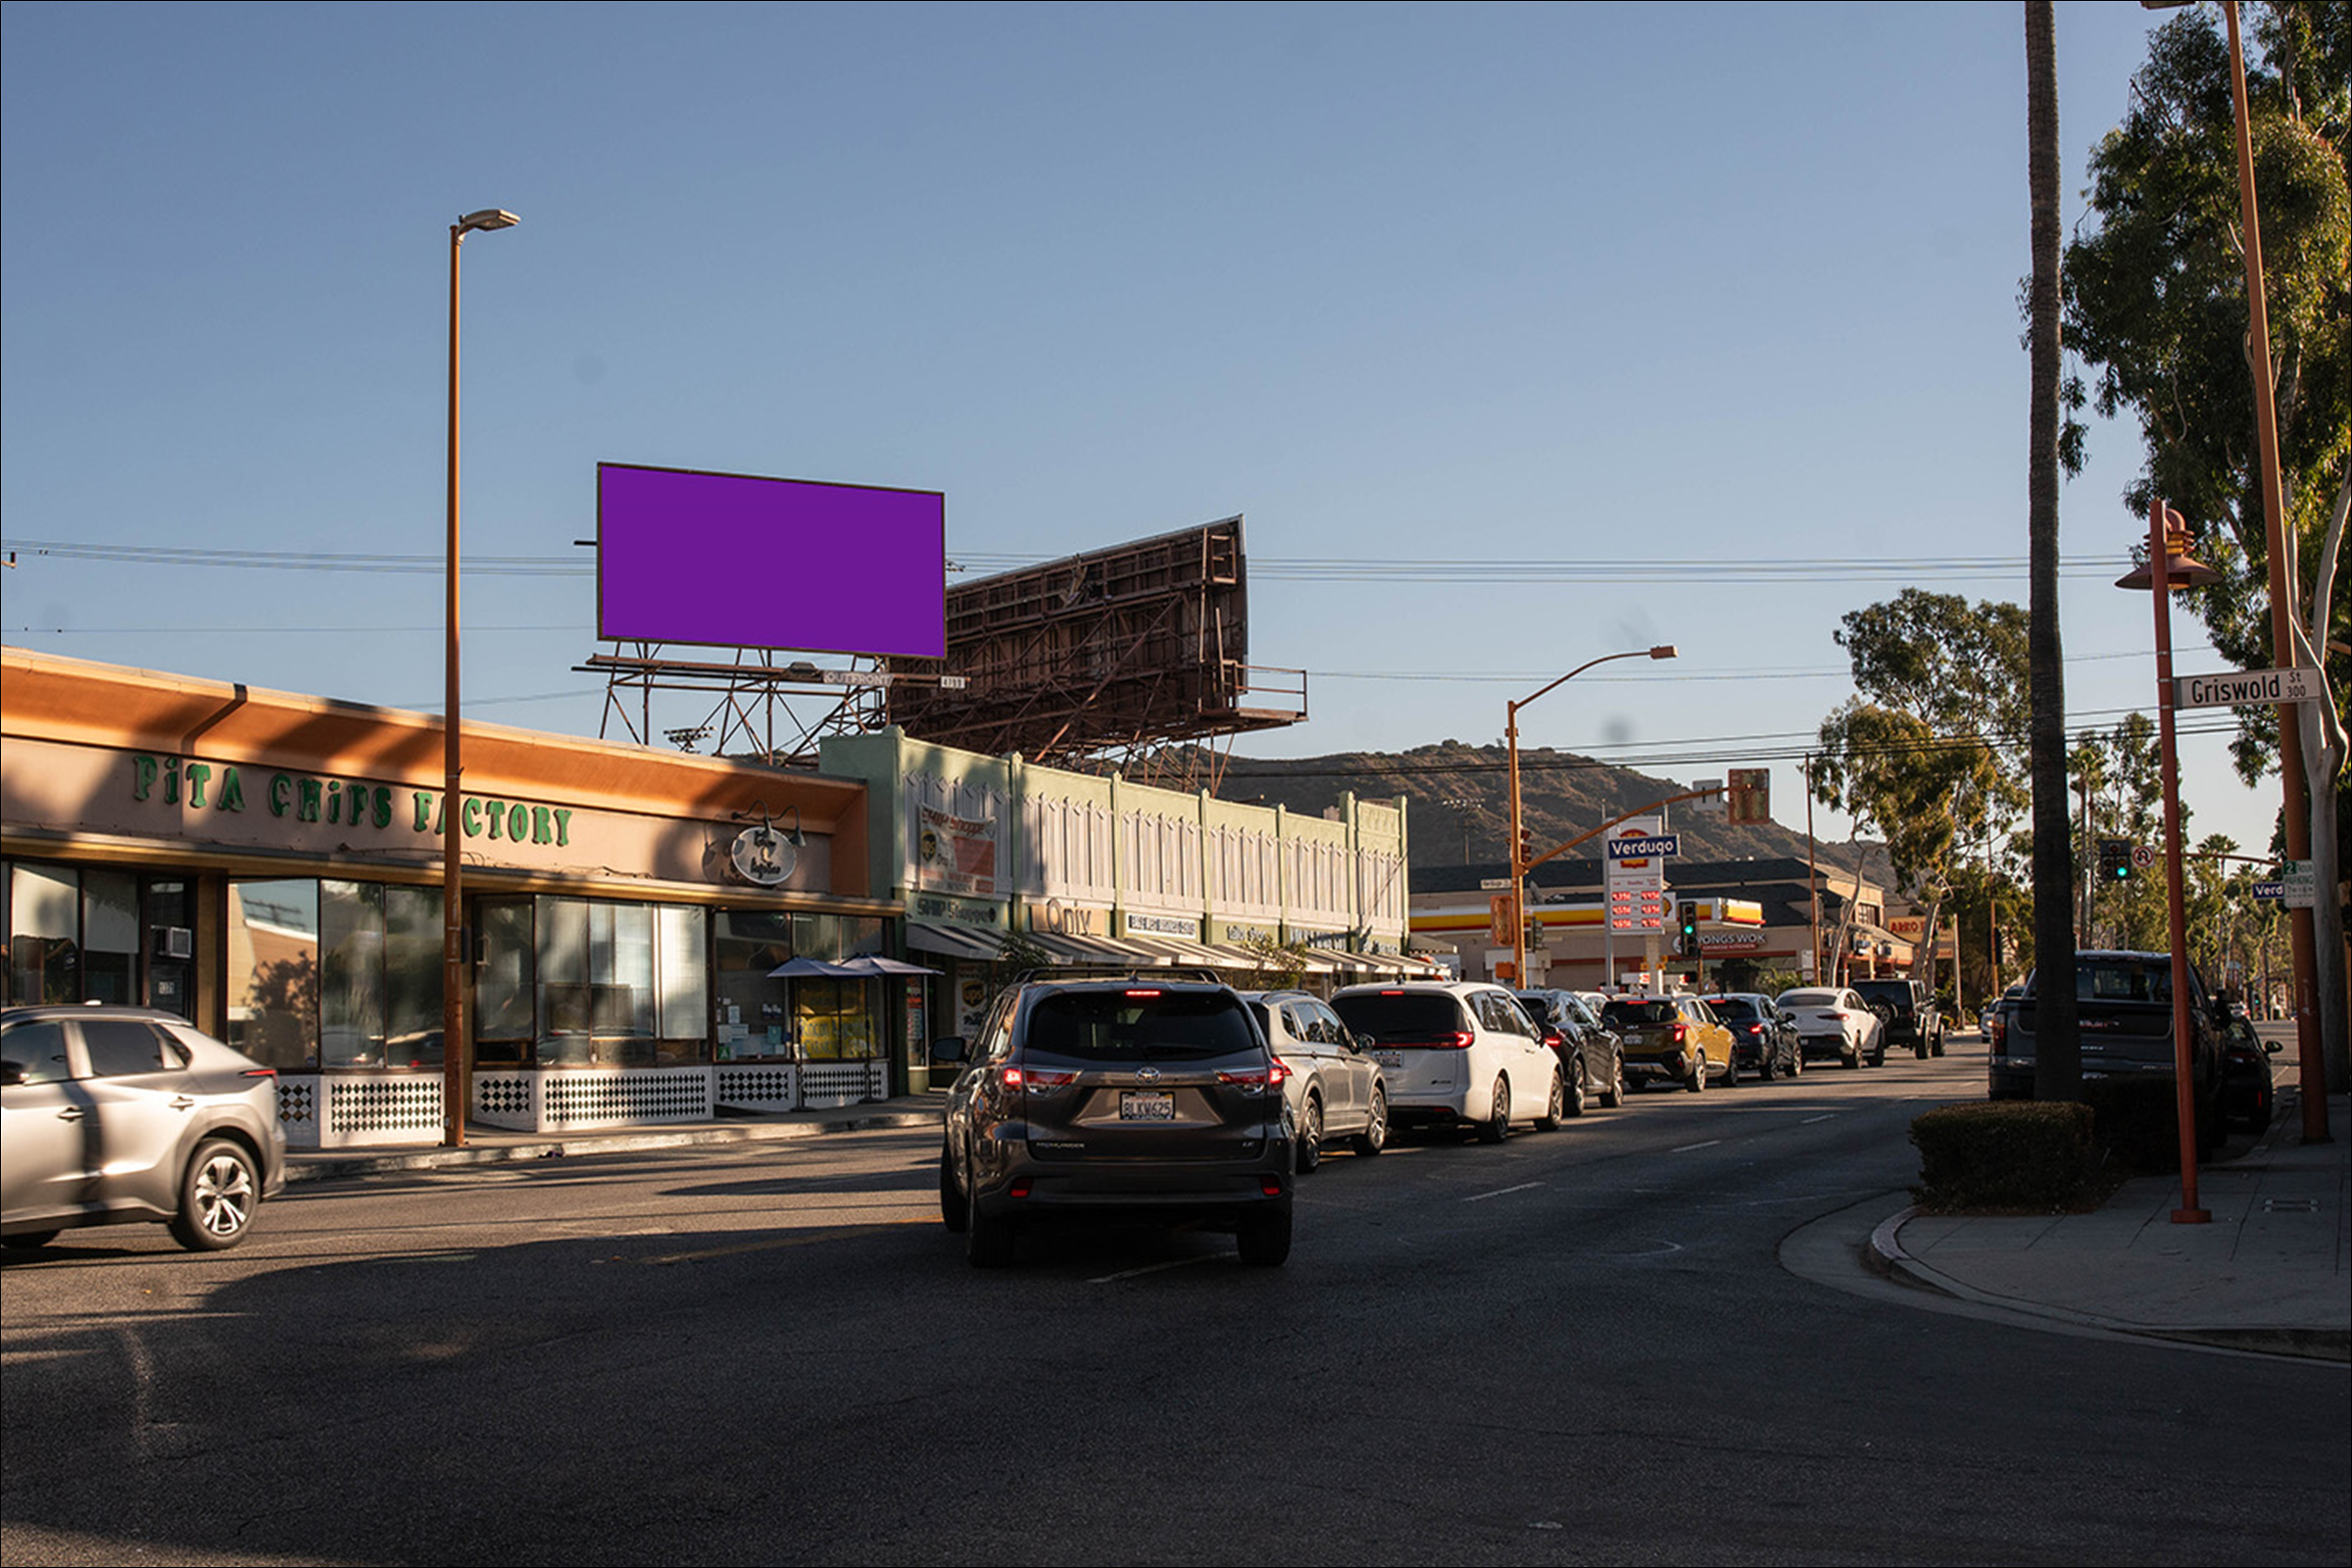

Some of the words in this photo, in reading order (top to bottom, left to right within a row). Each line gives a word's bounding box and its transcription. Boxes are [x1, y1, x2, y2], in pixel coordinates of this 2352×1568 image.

[2191, 674, 2281, 704] Griswold
[2289, 671, 2301, 683] St
[2286, 685, 2307, 698] 300
[1611, 838, 1675, 858] Verdugo
[2286, 862, 2294, 873] 2
[2254, 883, 2284, 896] Verd
[1737, 933, 1766, 944] WOK
